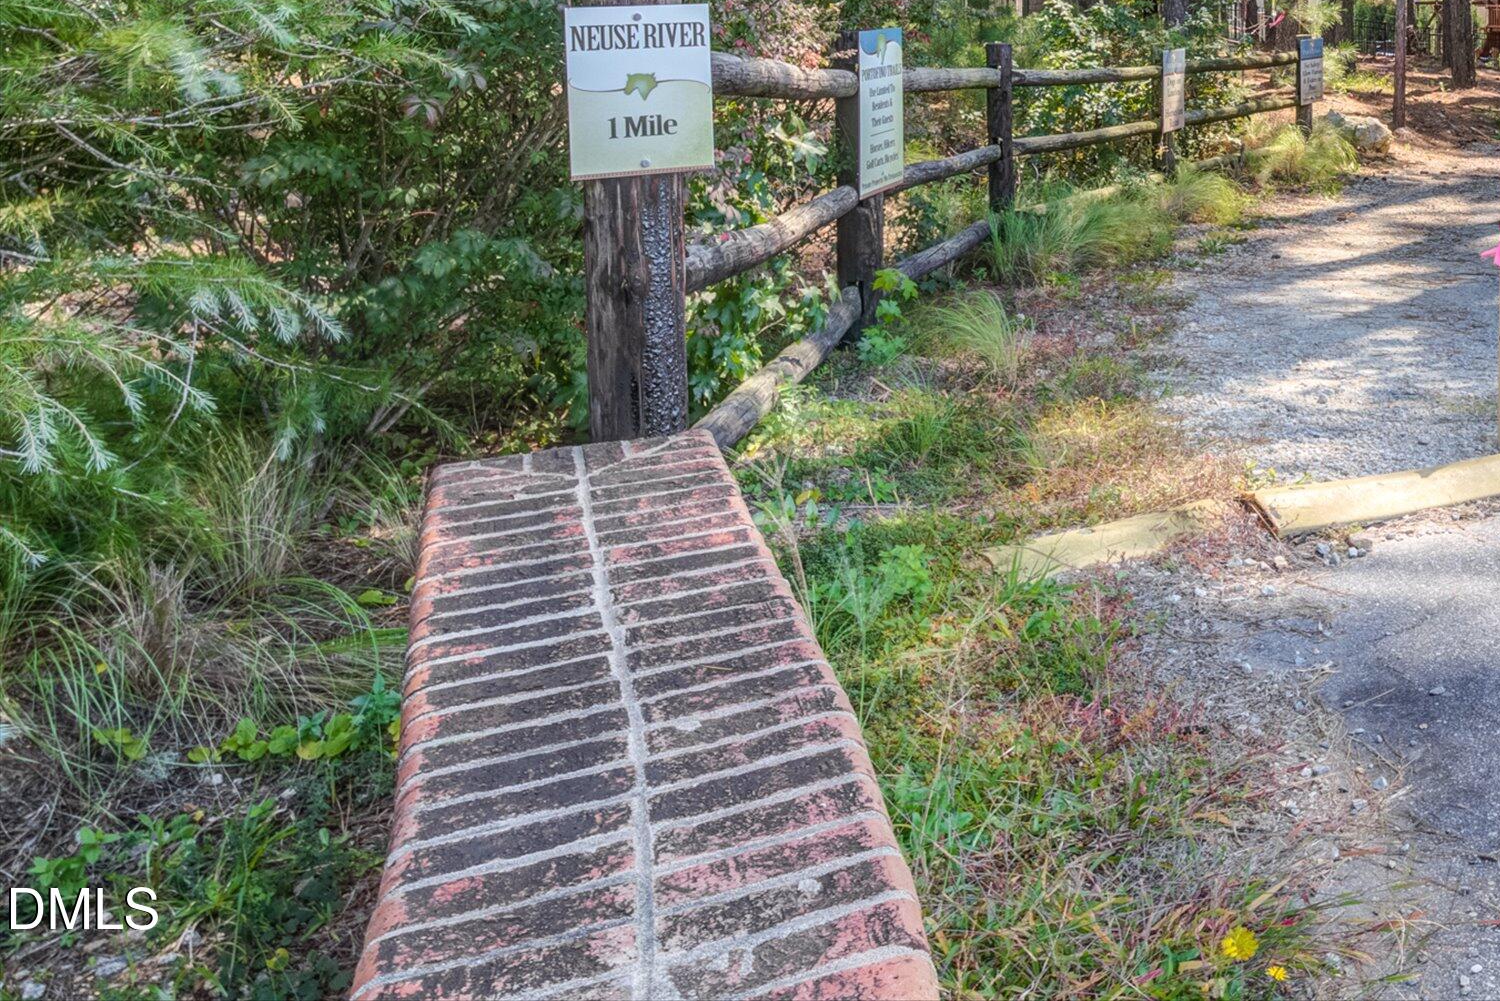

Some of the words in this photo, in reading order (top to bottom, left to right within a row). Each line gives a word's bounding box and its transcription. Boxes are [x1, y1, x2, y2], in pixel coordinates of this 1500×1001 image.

[570, 24, 640, 52] NEUSE
[643, 22, 706, 48] RIVER
[607, 117, 618, 139] 1
[623, 114, 678, 138] Mile
